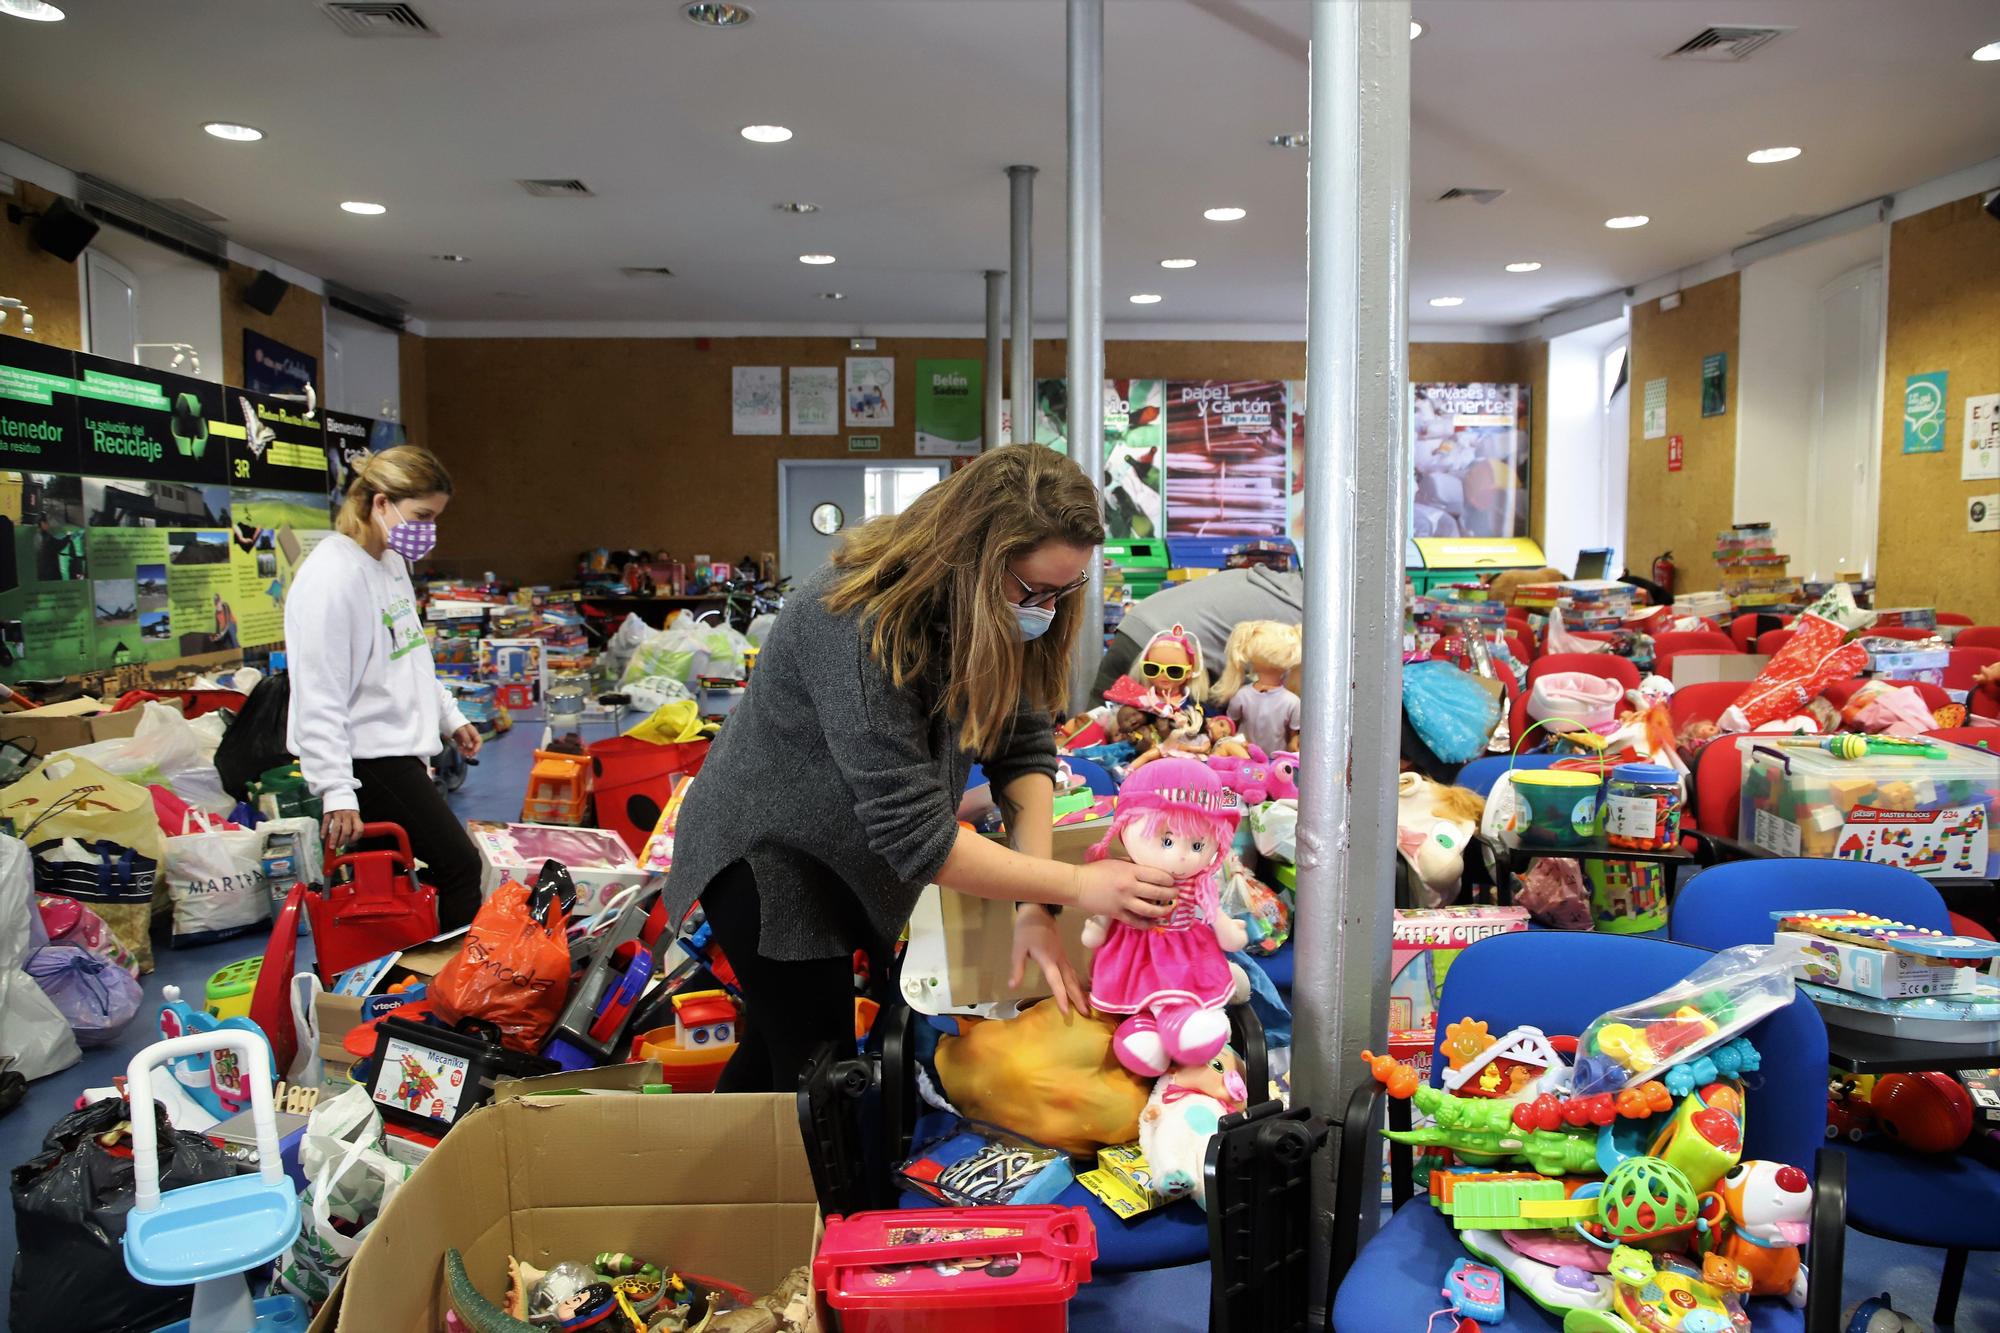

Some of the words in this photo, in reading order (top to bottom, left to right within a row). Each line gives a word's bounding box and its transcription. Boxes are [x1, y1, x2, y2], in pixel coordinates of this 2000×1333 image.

[1182, 384, 1231, 403] papel
[1427, 388, 1484, 400] envases
[1487, 388, 1497, 399] e
[1198, 401, 1209, 416] y
[1211, 398, 1271, 413] cartón
[1446, 400, 1513, 413] inertes
[85, 417, 97, 429] La
[98, 421, 131, 434] solución
[132, 425, 145, 436] del
[327, 417, 366, 437] Bienvenido
[93, 430, 163, 462] Reciclaje
[234, 459, 250, 478] 3R
[1942, 811, 1959, 819] 234
[372, 1001, 402, 1011] vtech
[428, 1051, 464, 1069] Mecaniko
